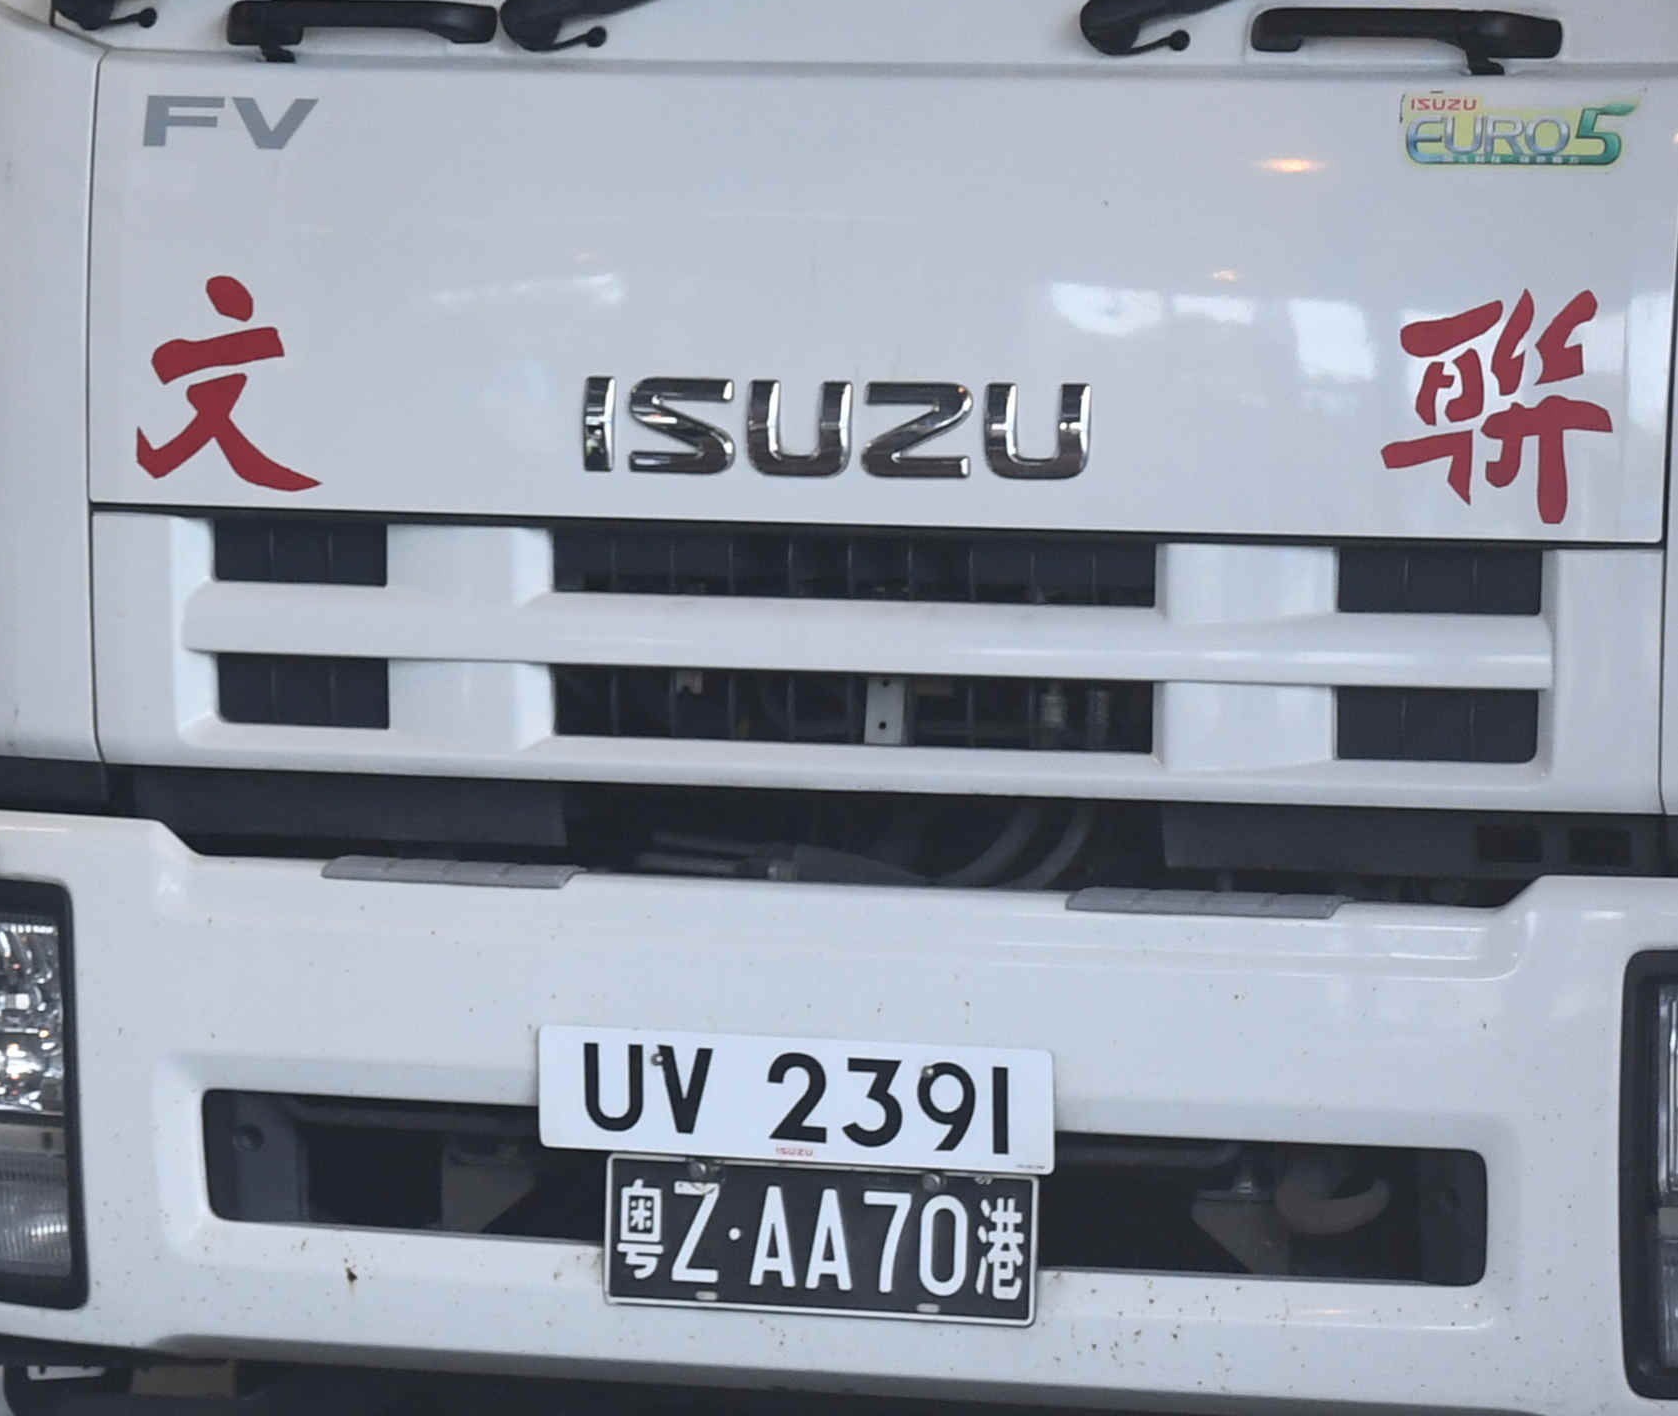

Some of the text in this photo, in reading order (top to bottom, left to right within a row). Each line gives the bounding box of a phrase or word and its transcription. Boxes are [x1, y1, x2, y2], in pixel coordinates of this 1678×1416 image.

[143, 96, 318, 150] FV
[1410, 97, 1477, 112] ISUZU
[136, 276, 321, 492] 文
[583, 375, 1091, 480] ISUZU
[1381, 289, 1613, 524] 聯
[584, 1042, 1010, 1155] UV 2391
